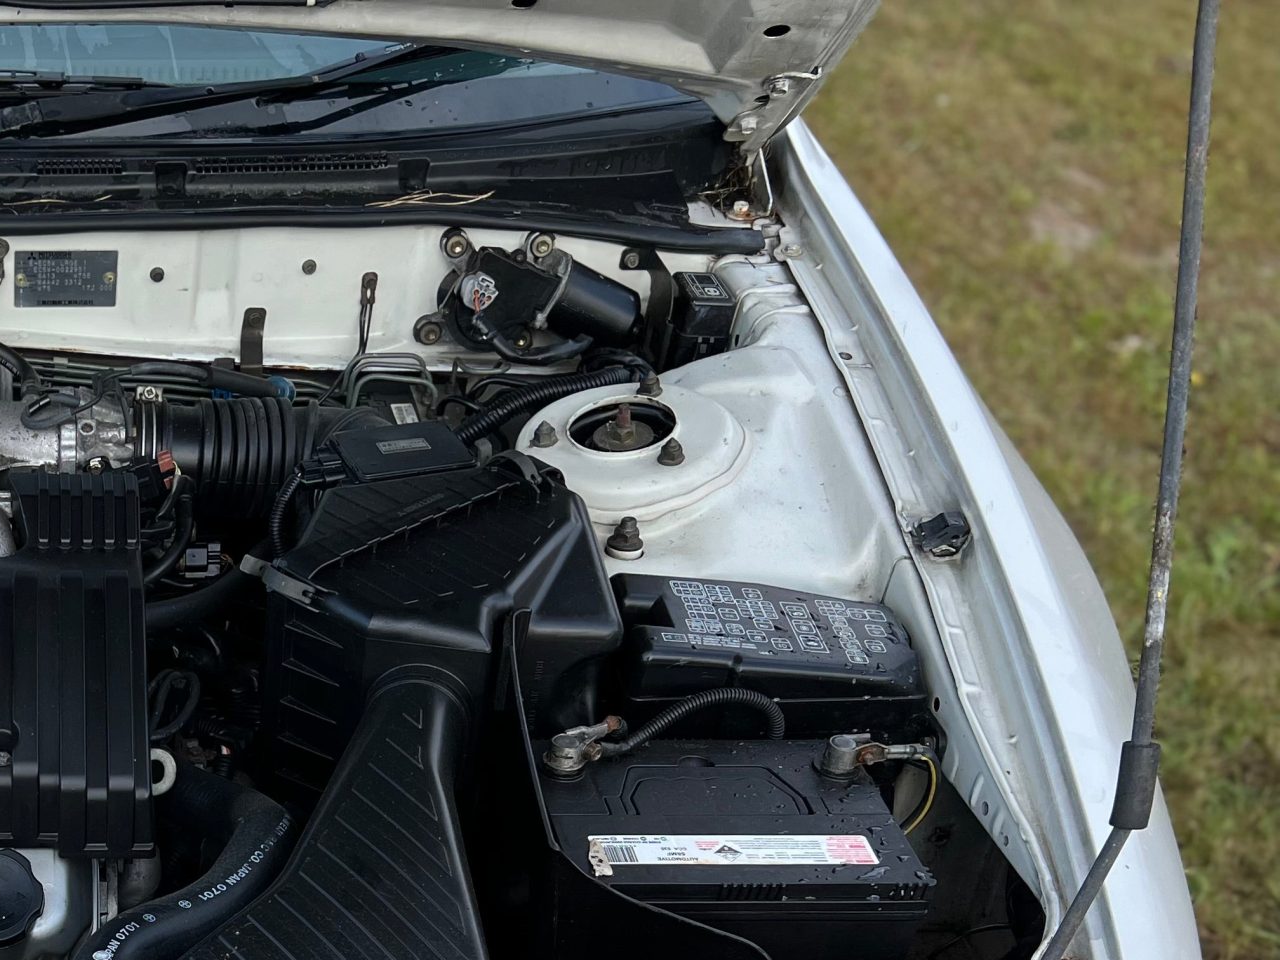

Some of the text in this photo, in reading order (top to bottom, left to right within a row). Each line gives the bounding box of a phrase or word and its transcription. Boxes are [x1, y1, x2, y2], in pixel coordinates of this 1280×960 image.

[198, 850, 264, 901] CO. JAPAN 0701
[116, 921, 140, 941] 0701
